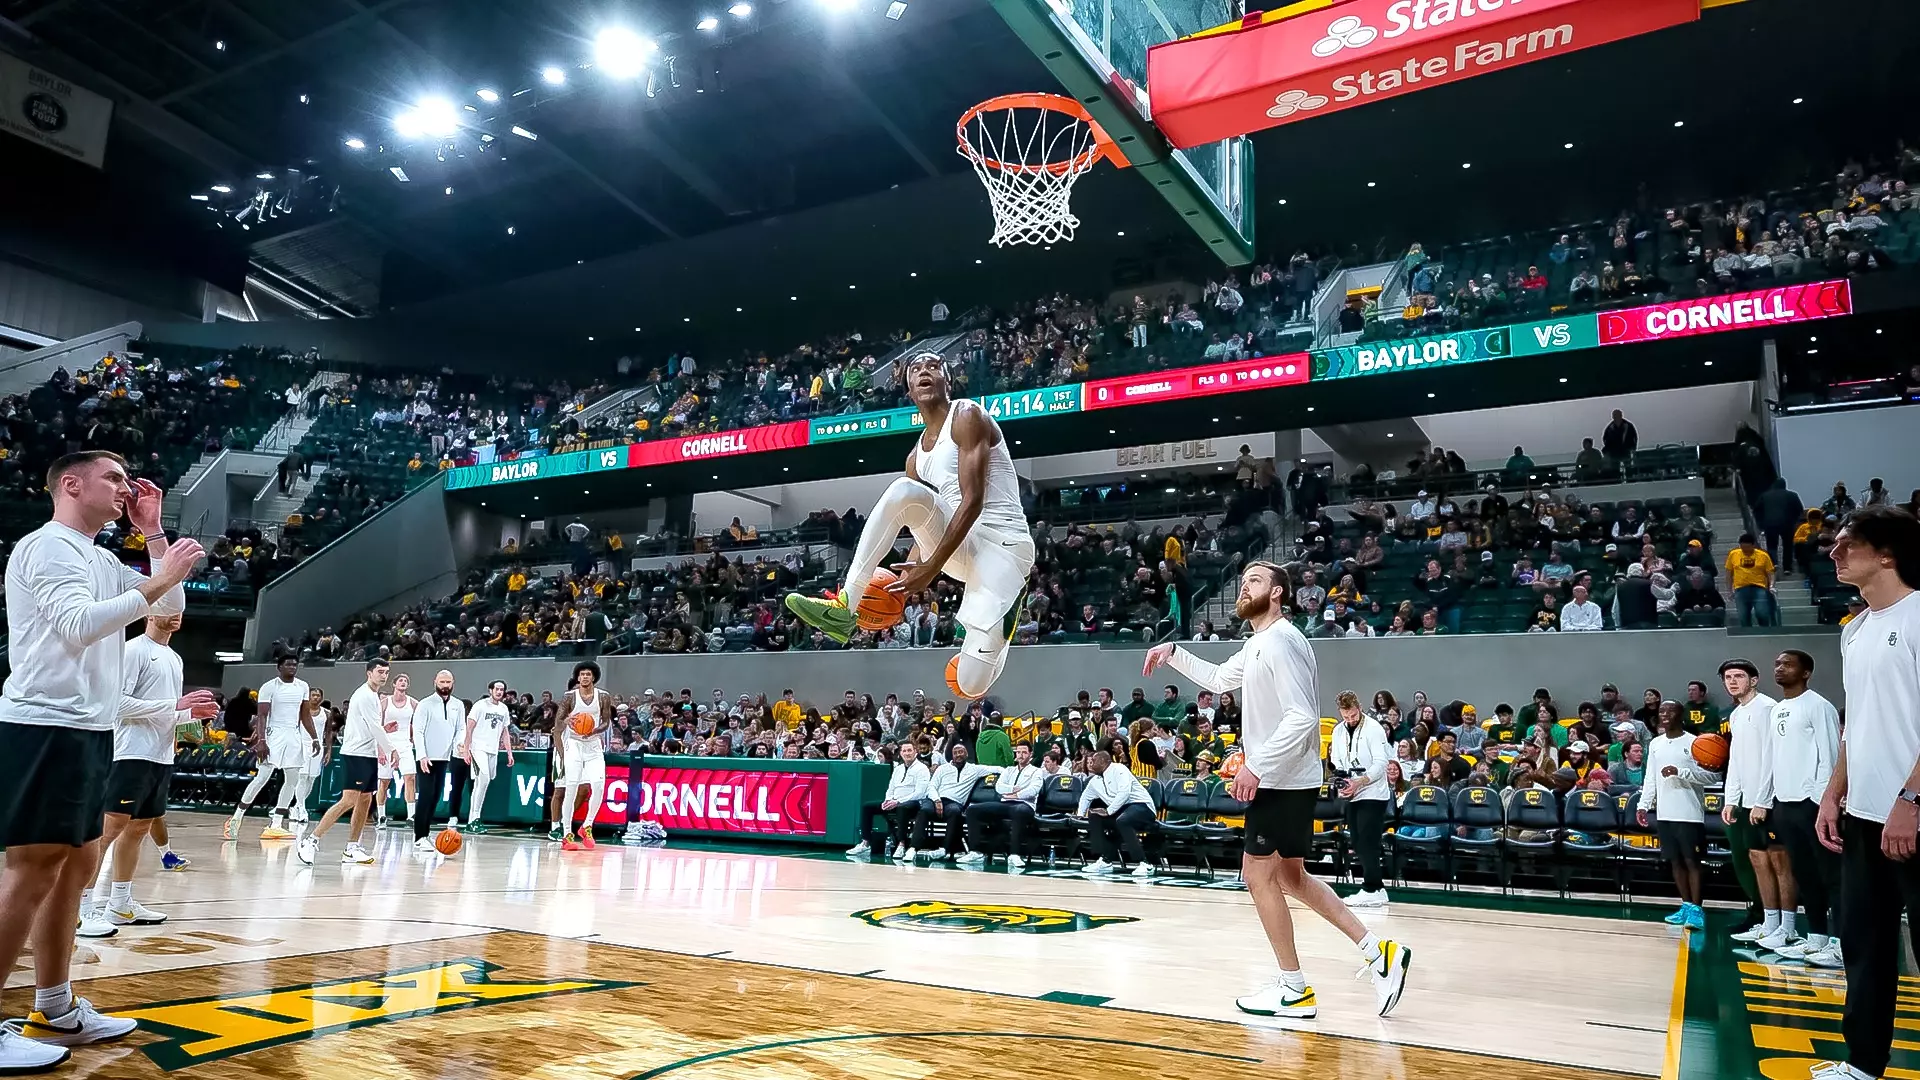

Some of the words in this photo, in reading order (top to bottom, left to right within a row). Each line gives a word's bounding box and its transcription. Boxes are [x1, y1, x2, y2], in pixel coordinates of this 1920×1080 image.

[1333, 53, 1449, 102] State
[1453, 23, 1574, 72] Farm
[28, 69, 72, 96] BAYLOR
[31, 108, 58, 127] FOUR
[32, 99, 59, 118] FINAL
[1646, 294, 1795, 334] CORNELL
[1533, 322, 1571, 349] VS
[1358, 336, 1459, 372] BAYLOR
[1198, 376, 1215, 386] FLS
[1219, 372, 1228, 384] 0
[1236, 371, 1247, 381] TO
[1053, 390, 1073, 403] 1ST
[1098, 387, 1108, 401] 0
[1125, 381, 1172, 396] CORNELL
[1049, 400, 1075, 413] HALF
[865, 420, 878, 430] FLS
[880, 417, 888, 429] 0
[681, 433, 747, 458] CORNELL
[1116, 445, 1165, 467] BEAR
[1171, 439, 1218, 461] FUEL
[600, 450, 617, 467] VS
[491, 461, 538, 482] BAYLOR
